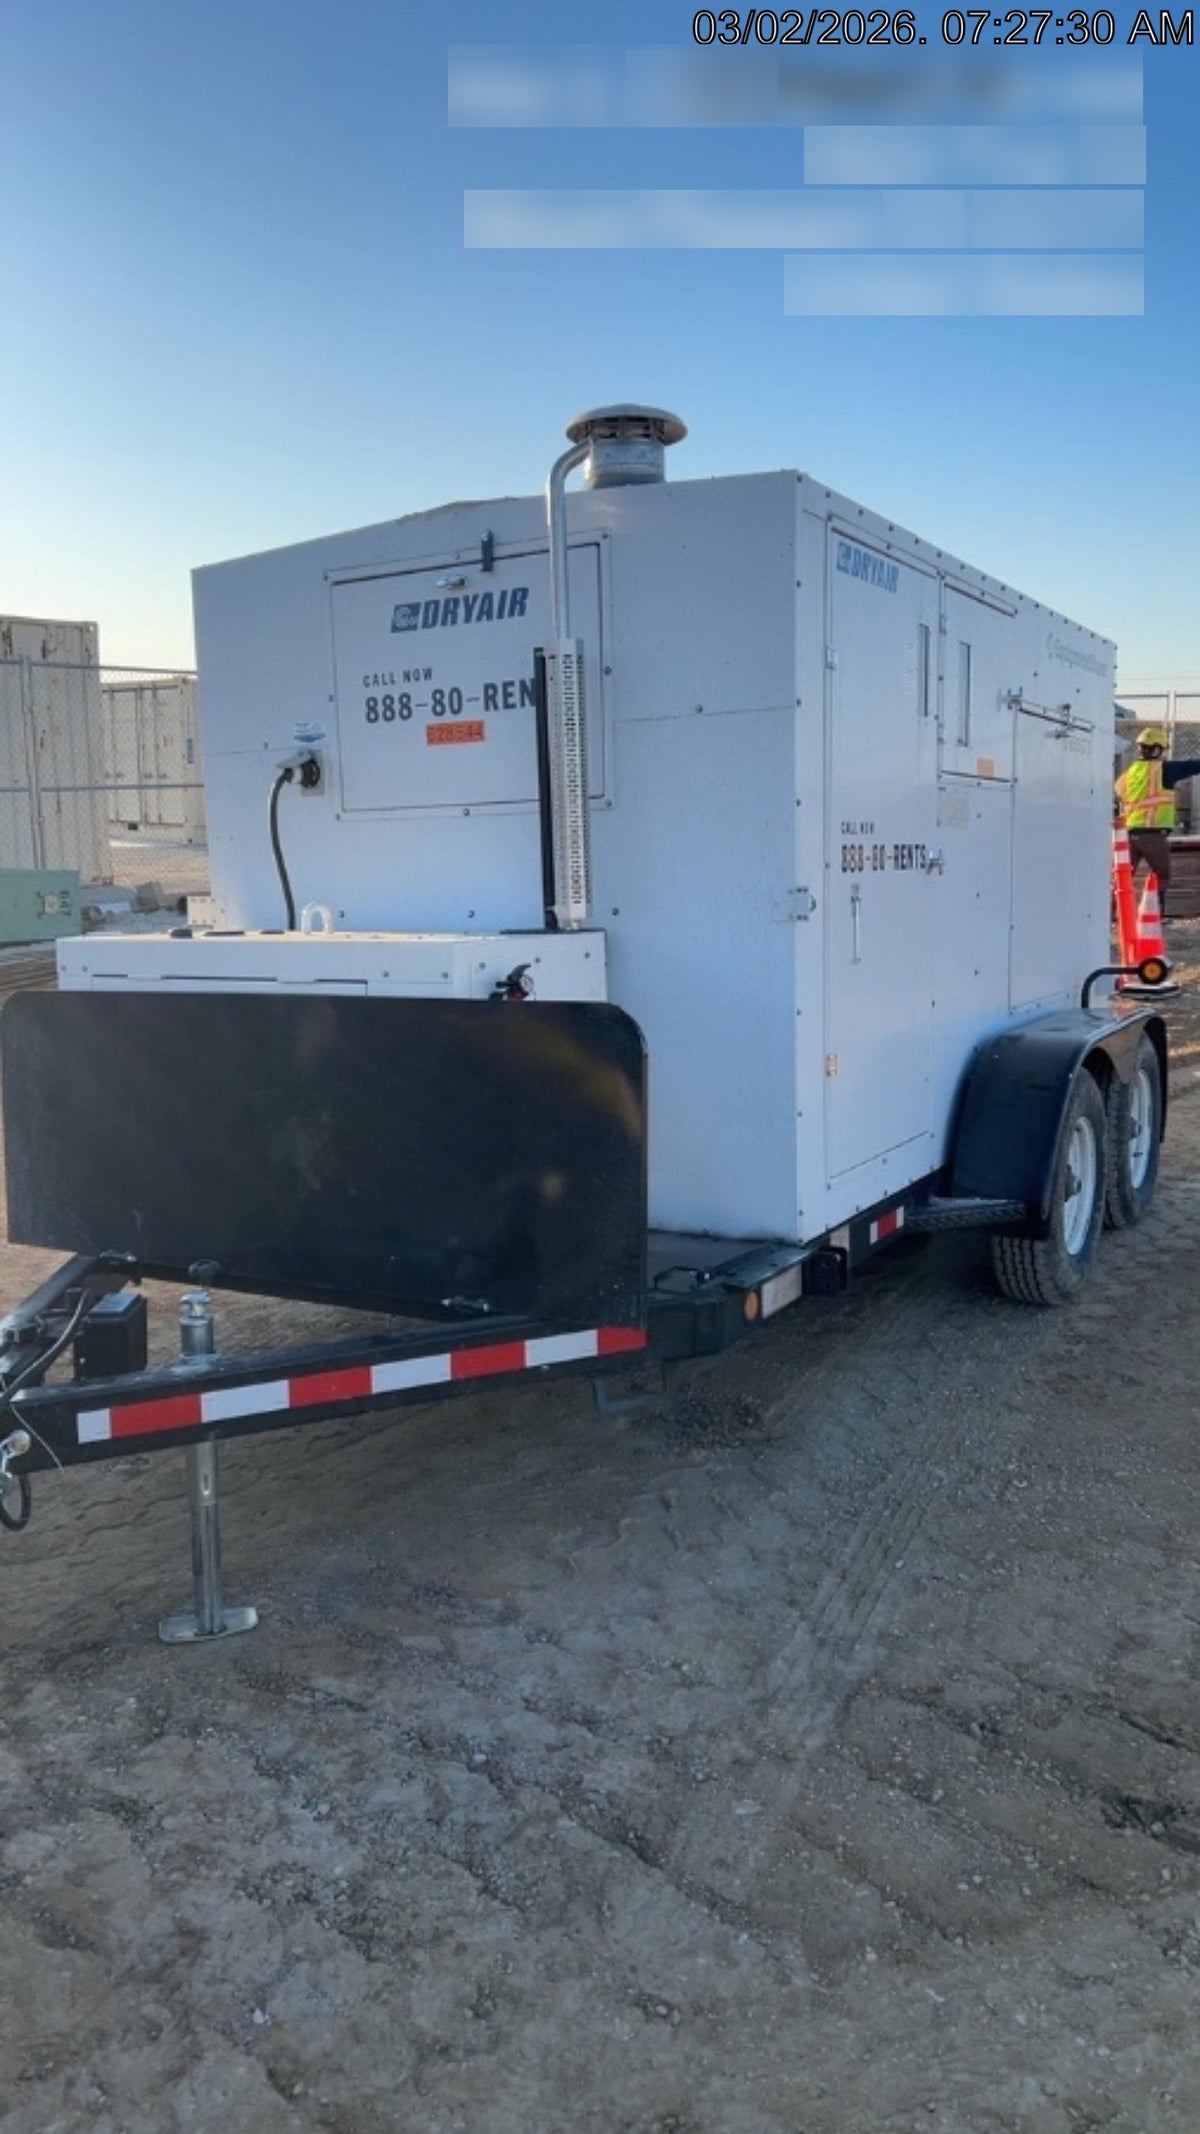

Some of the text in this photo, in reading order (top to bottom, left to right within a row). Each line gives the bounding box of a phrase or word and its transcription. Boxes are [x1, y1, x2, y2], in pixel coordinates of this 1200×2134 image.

[851, 547, 899, 594] DRYAIR
[421, 587, 529, 629] DRYAIR
[362, 667, 432, 688] CALL NOW
[365, 678, 537, 723] 888-80-REN
[841, 843, 926, 873] 888-80-RENTS
